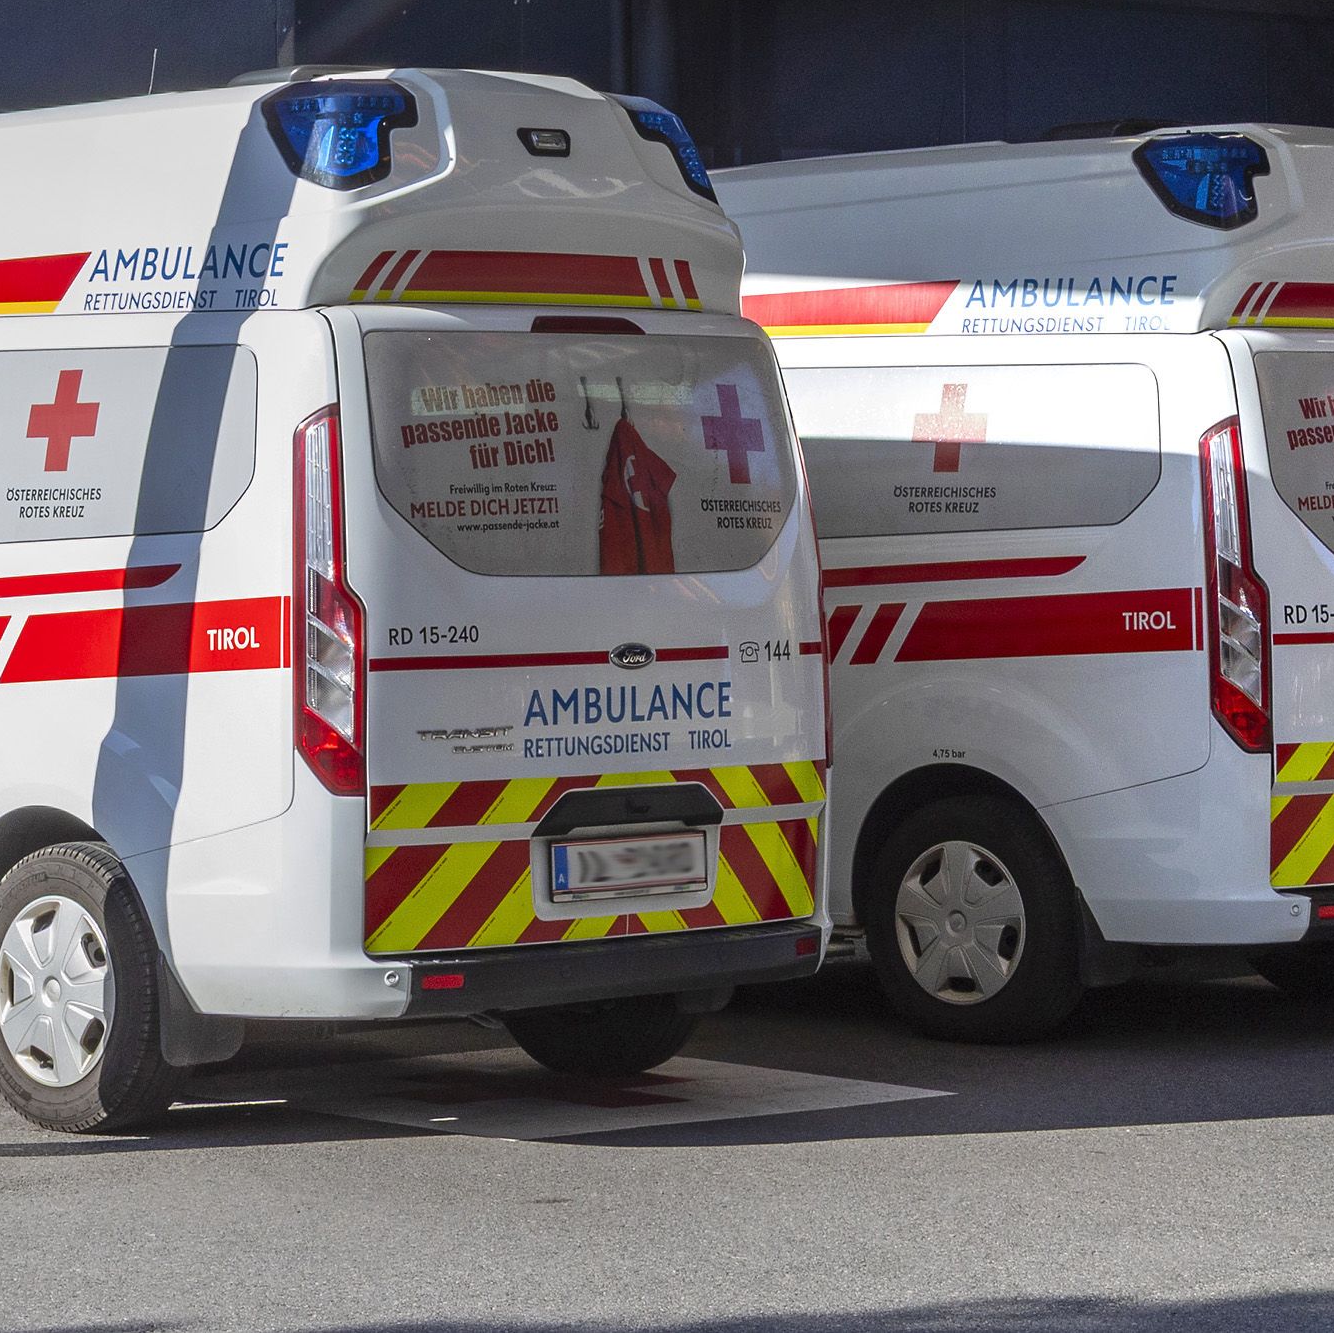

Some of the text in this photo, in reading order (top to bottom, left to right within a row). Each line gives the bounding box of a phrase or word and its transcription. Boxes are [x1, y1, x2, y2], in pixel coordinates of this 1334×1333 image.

[88, 242, 288, 282] AMBULANCE
[83, 289, 278, 311] RETTUNGSDIENST TIROL
[966, 275, 1177, 309] AMBULANCE
[962, 315, 1171, 333] RETTUNGSDIENST TIROL
[421, 379, 556, 413] Wir haben die
[1298, 397, 1327, 419] Wir
[401, 409, 559, 448] passende Jacke
[470, 438, 556, 469] für Dich!
[6, 488, 102, 501] ÖSTERREICHISCHES
[449, 483, 490, 496] Freiwillig
[492, 483, 503, 493] im
[504, 483, 529, 492] Roten
[893, 484, 996, 500] ÖSTERREICHISCHES
[19, 505, 85, 518] ROTES KREUZ
[410, 497, 559, 518] MELDE DICH JETZT!
[700, 498, 781, 512] ÖSTERREICHISCHES
[908, 500, 979, 514] ROTES KREUZ
[457, 520, 560, 533] www.passende-jacke.at
[717, 517, 773, 529] ROTES KREUZ
[1122, 610, 1176, 632] TIROL
[1284, 605, 1307, 624] RD
[207, 627, 260, 650] TIROL
[388, 625, 480, 646] RD 15-240
[622, 651, 648, 663] Ford
[764, 639, 792, 662] 144
[523, 681, 732, 727] AMBULANCE
[417, 725, 514, 741] TRANSIT
[523, 728, 732, 758] RETTUNGSDIENST TIROL
[932, 749, 966, 759] 4,75 bar
[558, 873, 566, 884] A
